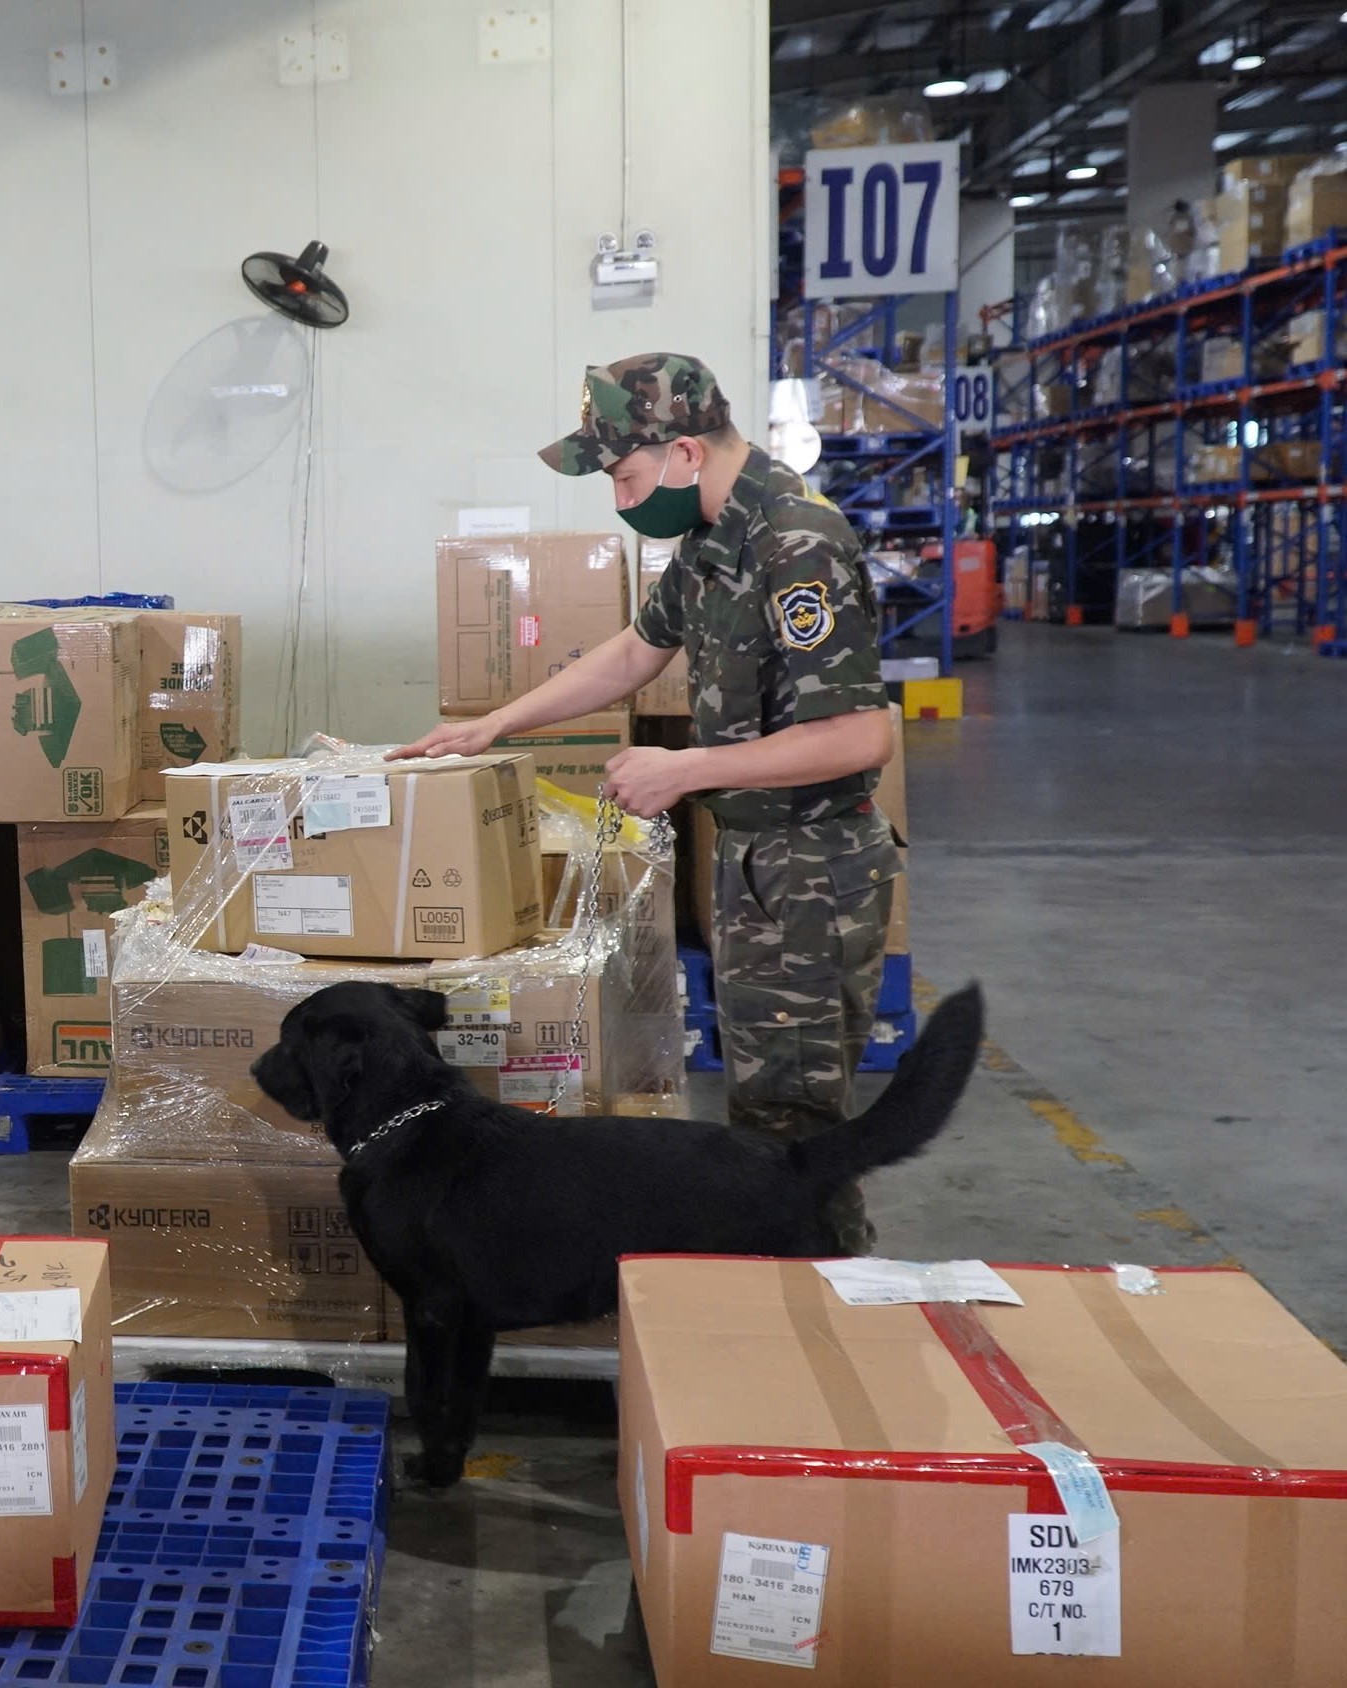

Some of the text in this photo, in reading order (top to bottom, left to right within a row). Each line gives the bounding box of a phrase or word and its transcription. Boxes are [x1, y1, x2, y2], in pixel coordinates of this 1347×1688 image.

[819, 161, 942, 280] I07
[956, 373, 988, 421] 08
[80, 771, 92, 799] OK
[419, 912, 459, 924] L0050
[156, 1028, 254, 1048] KYOCERA
[457, 1033, 499, 1046] 32-40
[114, 1207, 211, 1228] KYOCERA
[12, 1410, 27, 1418] AIR
[1030, 1524, 1080, 1549] SDV
[1011, 1557, 1102, 1575] IMK2303-
[722, 1574, 744, 1584] 180
[754, 1578, 784, 1590] 3416
[791, 1584, 820, 1595] 2881
[1040, 1580, 1074, 1597] 679
[732, 1592, 756, 1602] HAN
[792, 1615, 811, 1625] ICN
[1029, 1602, 1087, 1619] C/T NO.
[1053, 1621, 1061, 1641] 1
